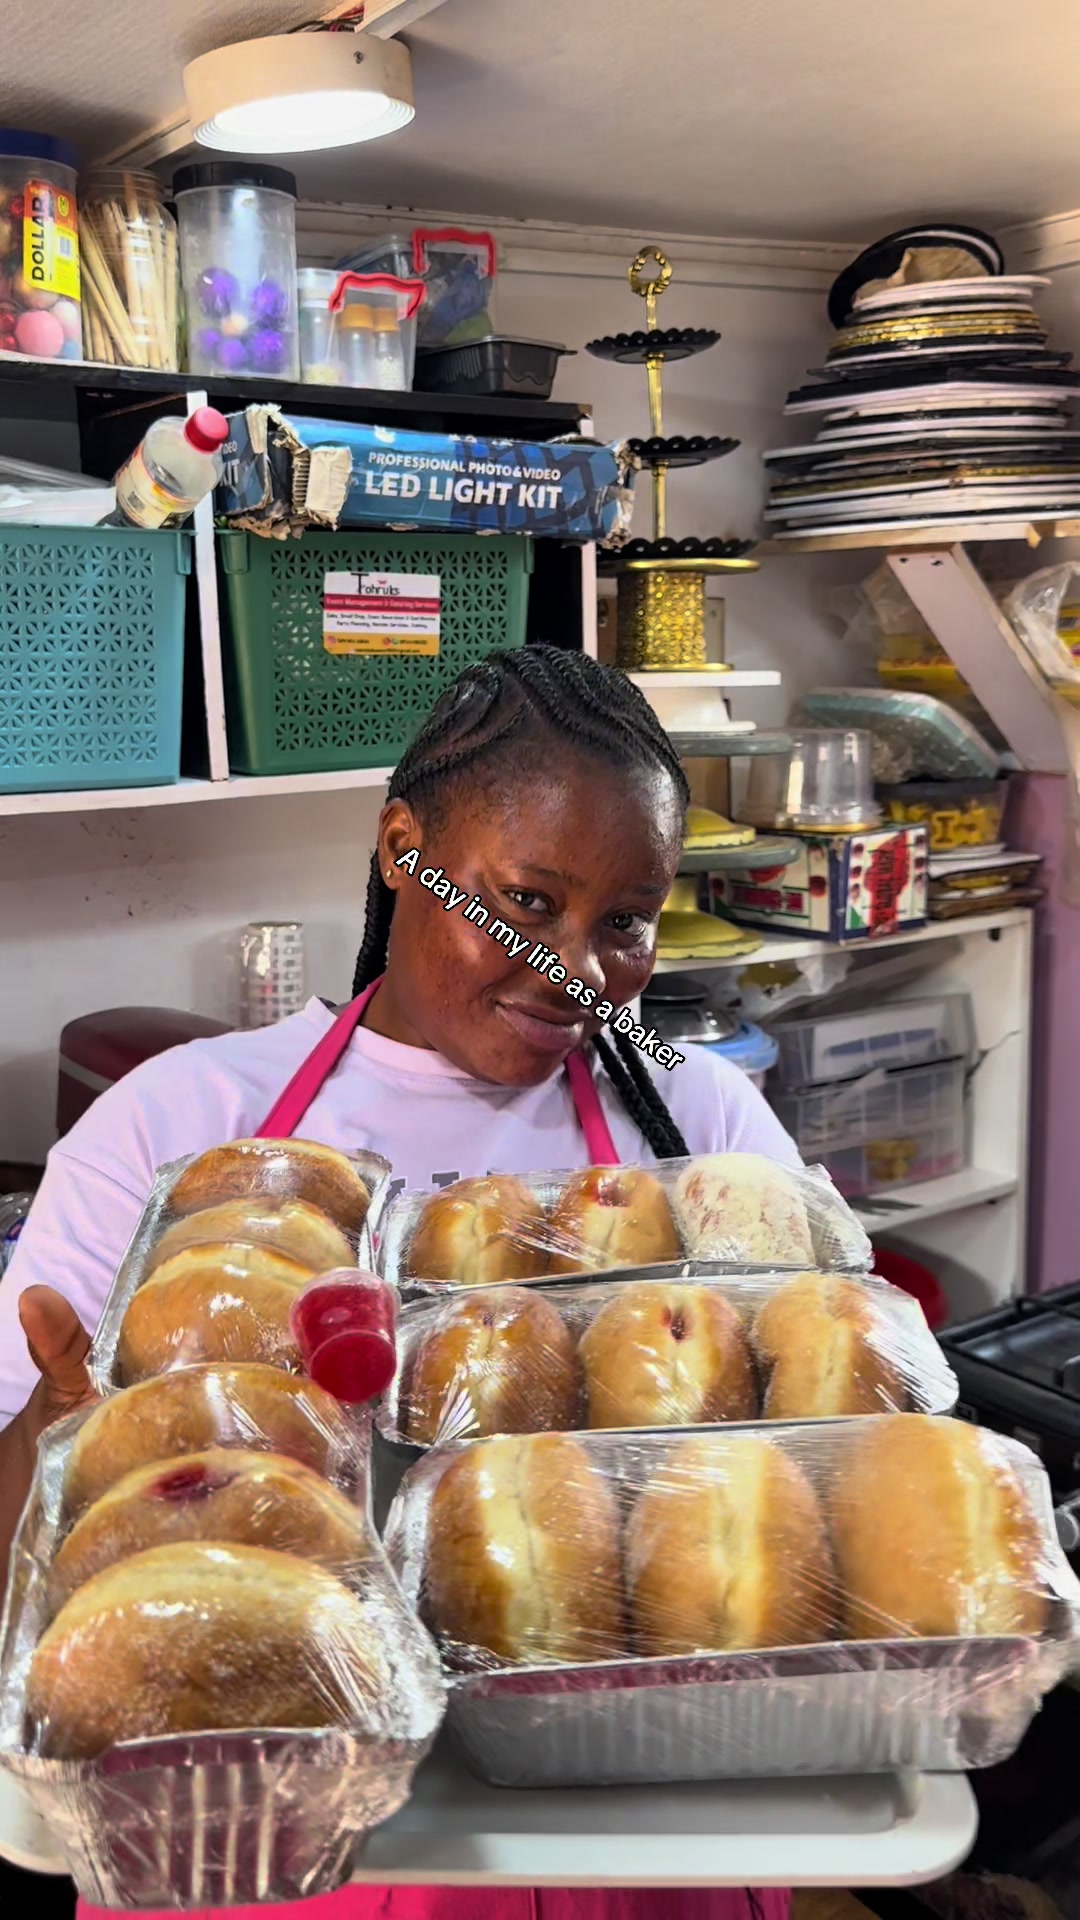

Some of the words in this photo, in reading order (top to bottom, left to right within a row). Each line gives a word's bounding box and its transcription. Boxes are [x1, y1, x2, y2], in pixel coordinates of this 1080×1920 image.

[368, 451, 466, 473] PROFESSIONAL
[364, 470, 421, 498] LED
[428, 475, 513, 506] LIGHT
[517, 484, 563, 509] KIT
